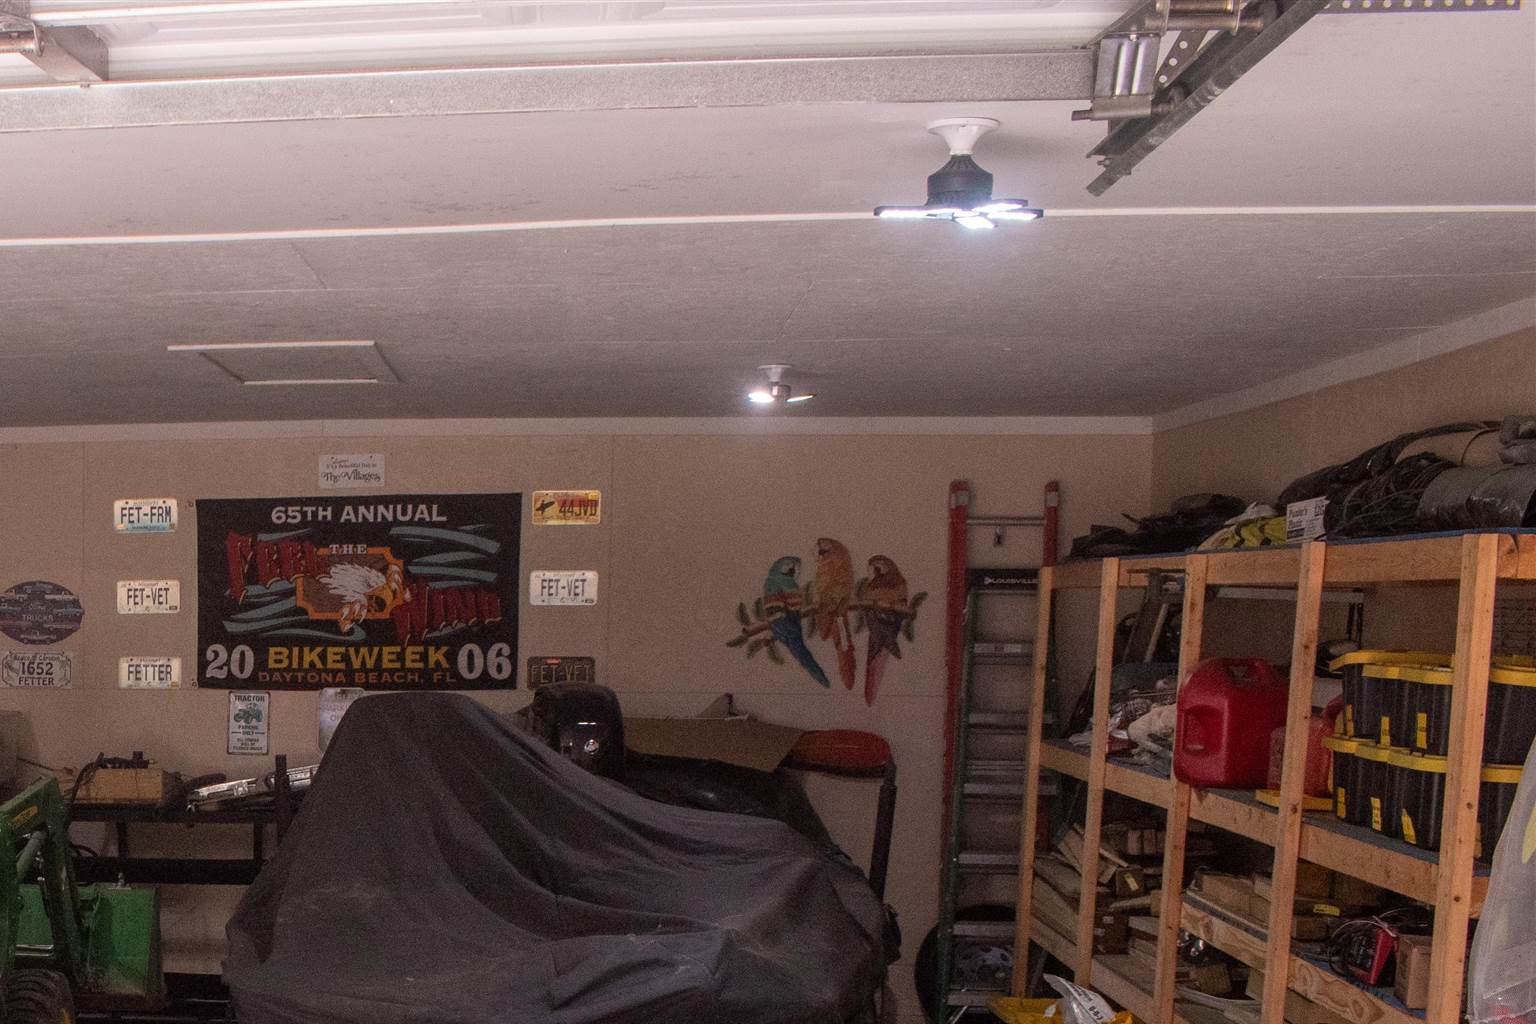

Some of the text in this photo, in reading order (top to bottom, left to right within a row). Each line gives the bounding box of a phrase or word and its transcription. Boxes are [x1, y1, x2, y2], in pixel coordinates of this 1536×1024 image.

[341, 469, 381, 482] Villages
[121, 506, 172, 524] FET-FRM
[271, 504, 447, 524] 65TH ANNUAL
[329, 544, 368, 555] THE
[127, 588, 170, 605] FET-VET
[541, 579, 587, 597] FET-VET
[21, 662, 54, 676] 1652
[206, 643, 513, 680] 20 BIKEWEEK 06
[127, 664, 172, 681] FETTER
[258, 672, 346, 684] DAYTONA
[433, 671, 456, 683] FL
[18, 677, 54, 686] FETTER
